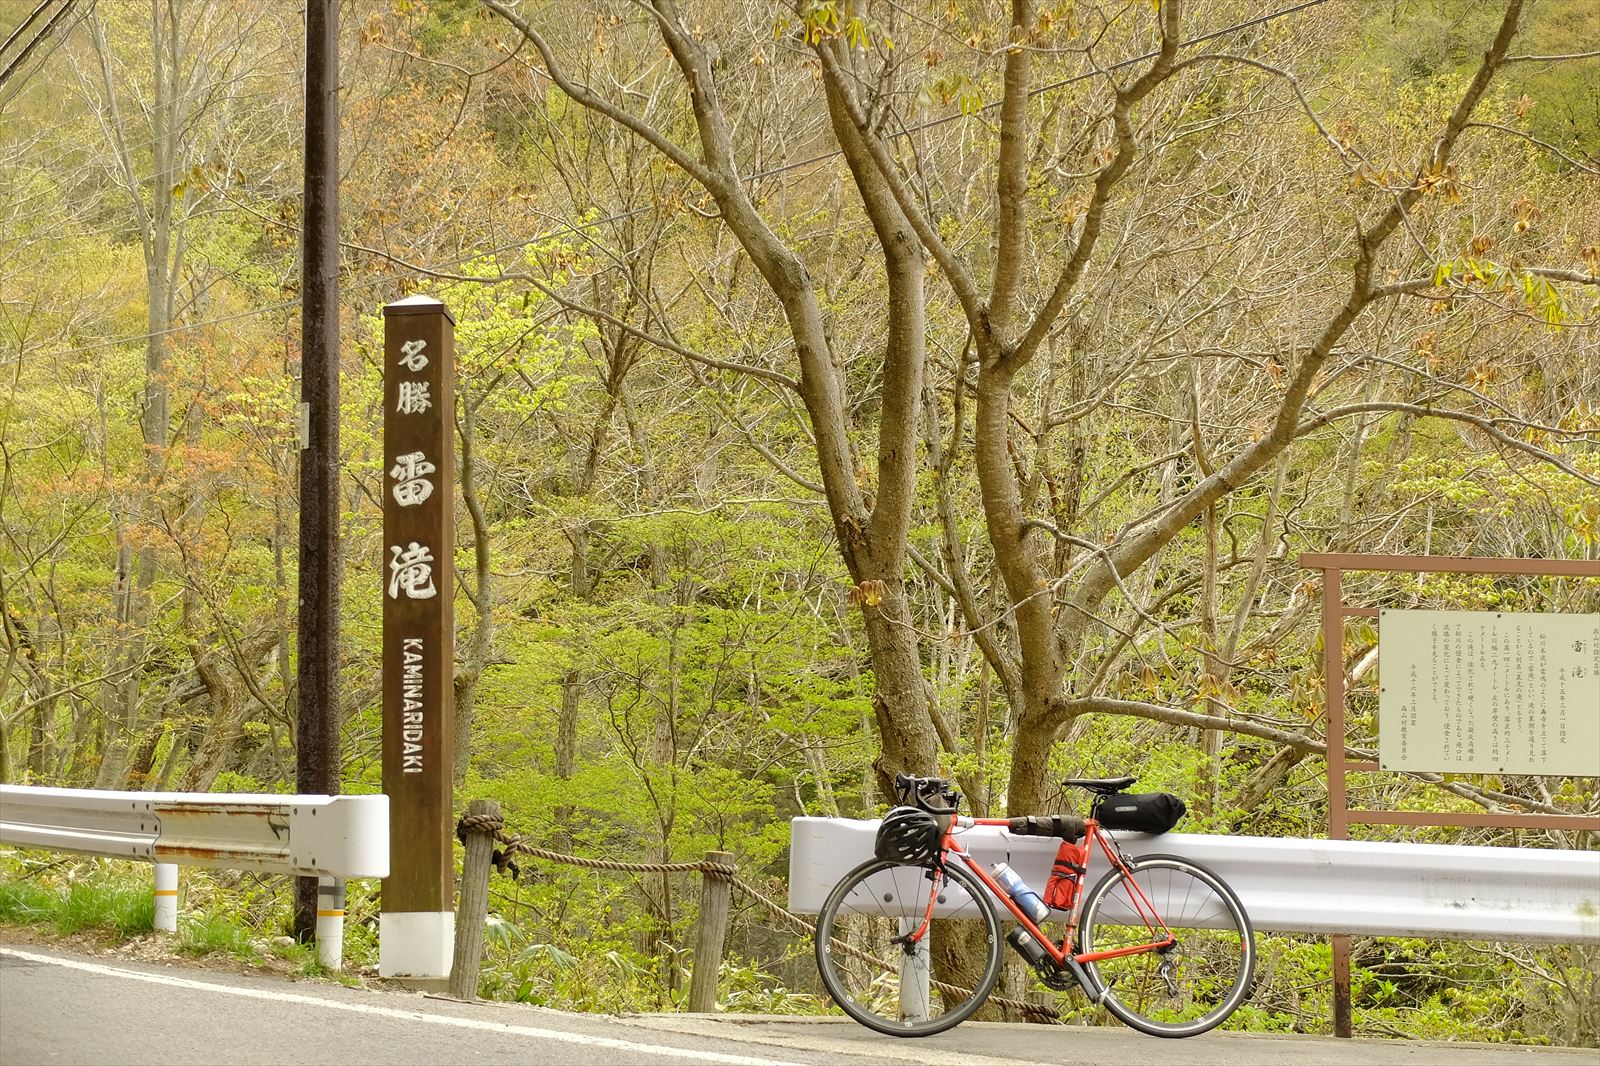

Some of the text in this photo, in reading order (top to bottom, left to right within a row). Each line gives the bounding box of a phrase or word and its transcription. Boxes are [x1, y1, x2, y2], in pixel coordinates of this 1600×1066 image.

[388, 339, 437, 600] 名勝 雷滝
[403, 638, 423, 773] KAMINARIDAKI
